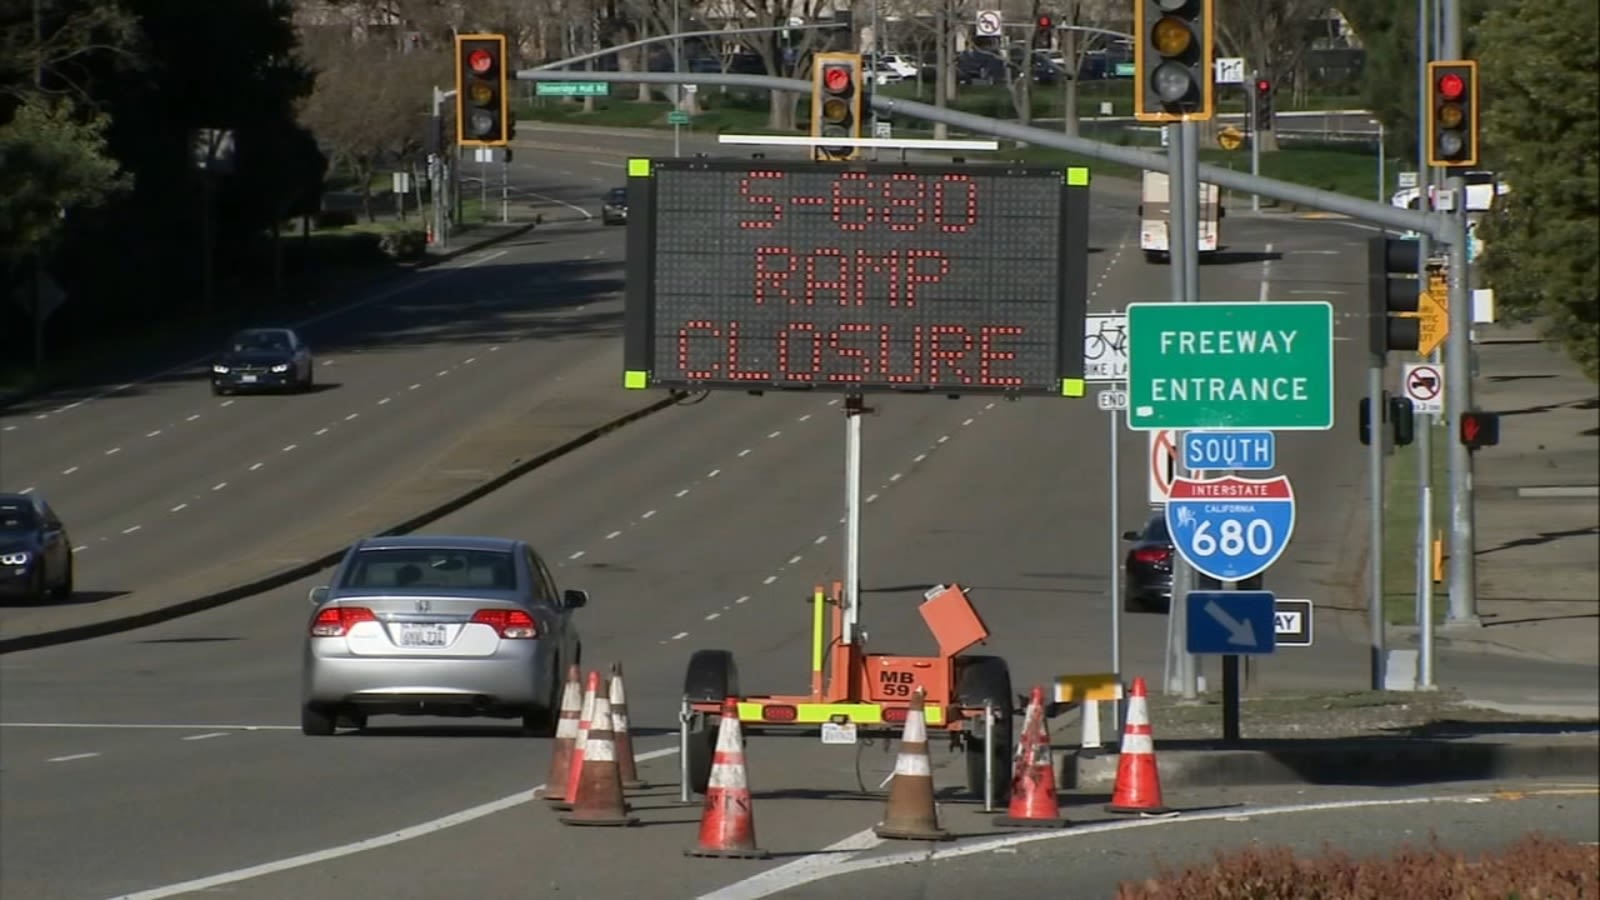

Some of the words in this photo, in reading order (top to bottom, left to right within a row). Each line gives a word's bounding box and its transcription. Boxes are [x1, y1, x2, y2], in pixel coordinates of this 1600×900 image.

[739, 170, 977, 232] S-680
[756, 247, 950, 307] RAMP
[1160, 330, 1297, 354] FREEWAY
[678, 320, 1024, 385] CLOSURE
[1113, 362, 1127, 376] LA
[1152, 377, 1308, 401] ENTRANCE
[1101, 393, 1126, 407] END
[1190, 438, 1269, 463] SOUTH
[1191, 484, 1268, 496] INTERSTATE
[1204, 504, 1256, 513] CALIFORNIA
[1191, 518, 1273, 557] 680
[1275, 614, 1295, 631] AY
[880, 671, 914, 684] MB
[883, 684, 909, 697] 59
